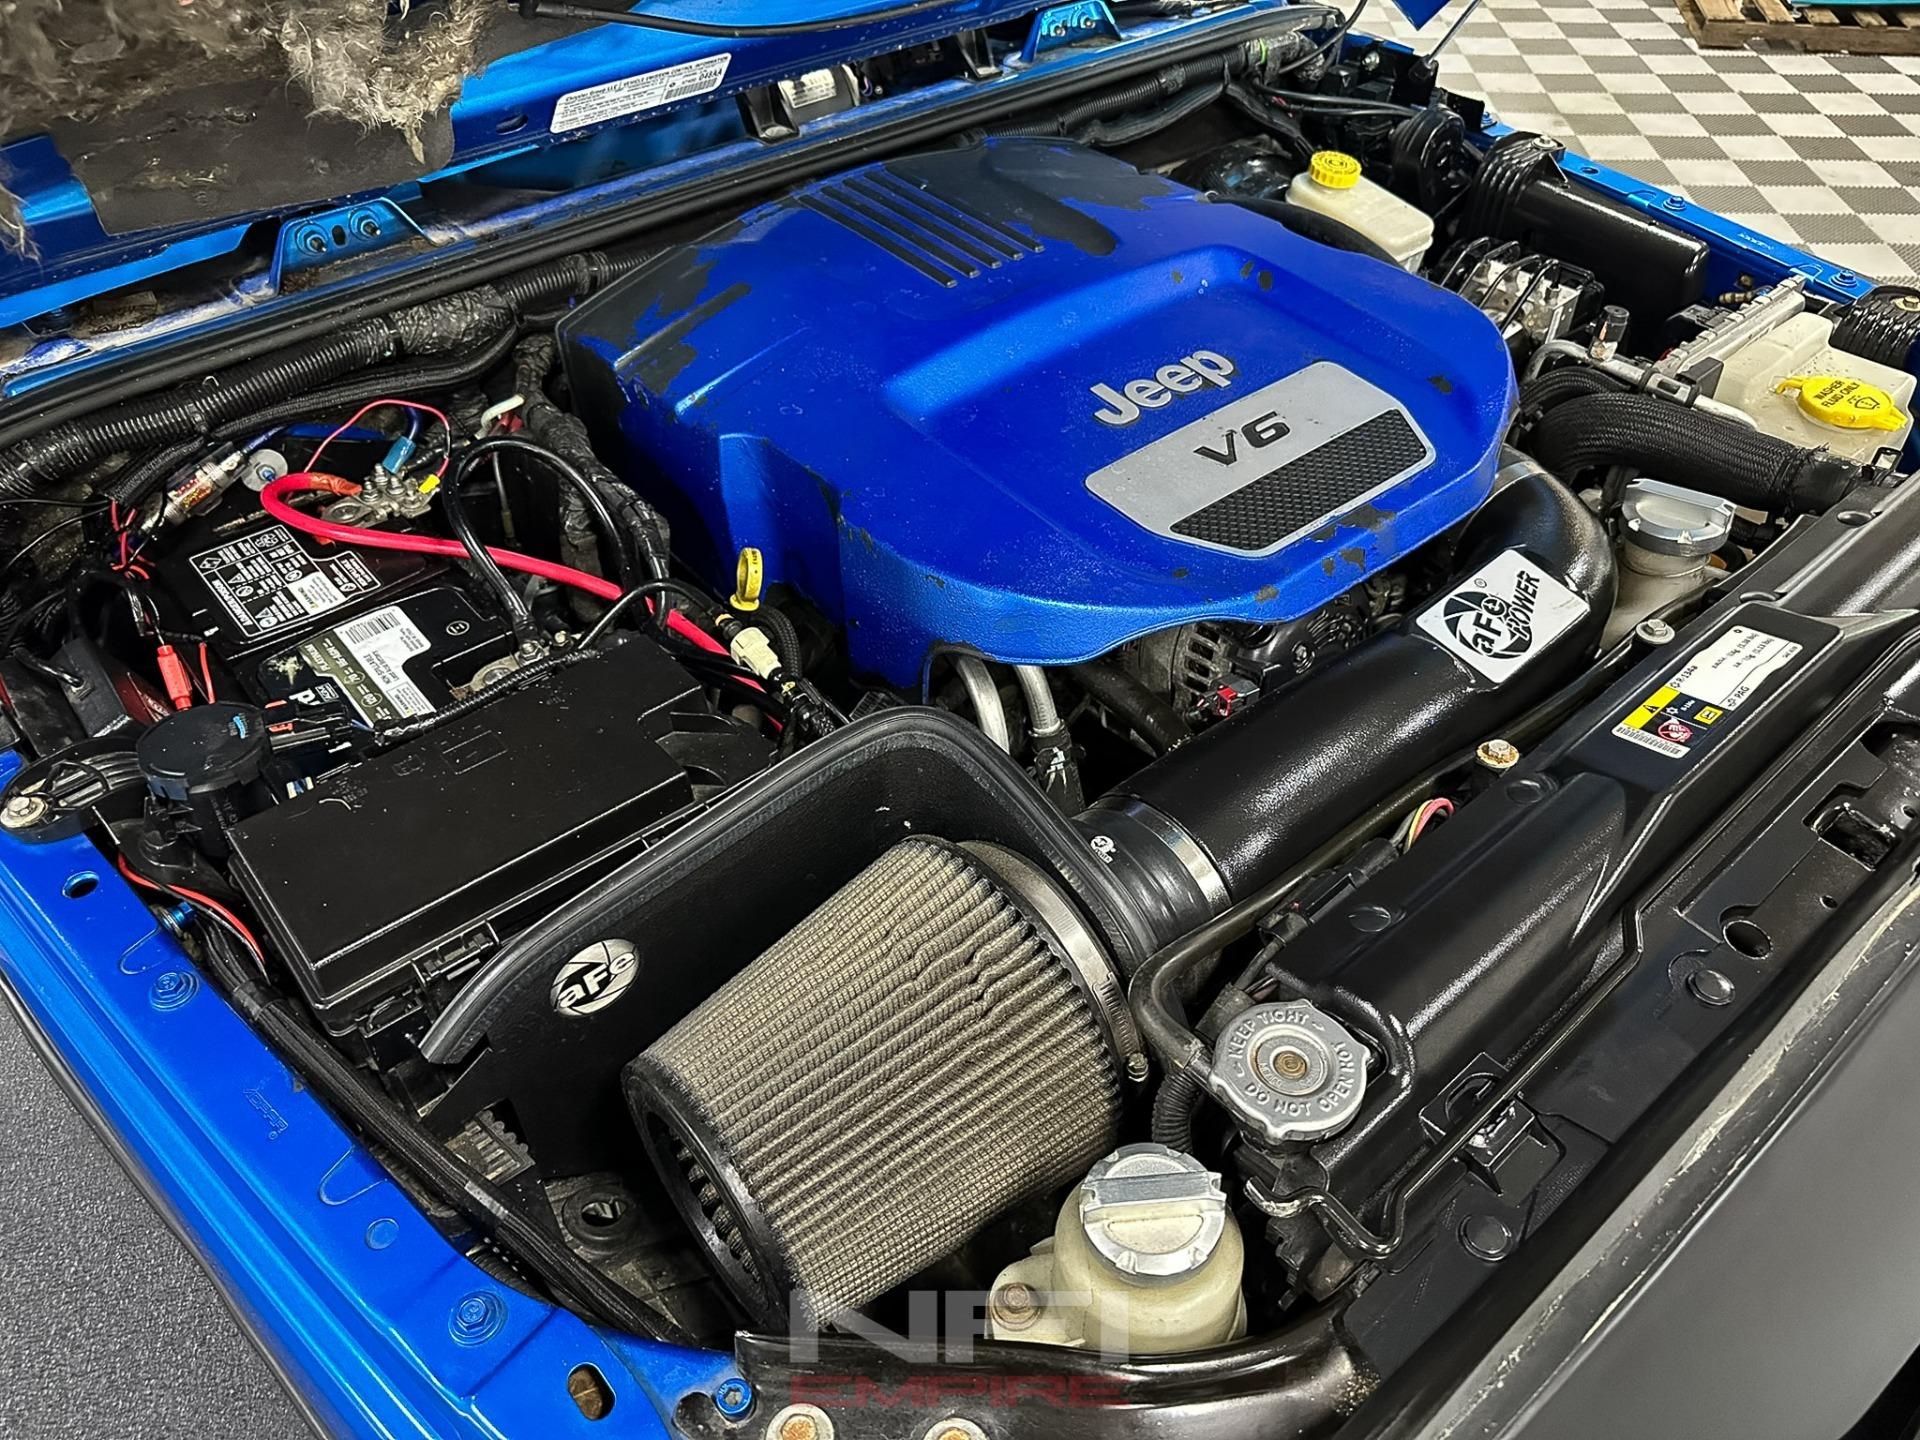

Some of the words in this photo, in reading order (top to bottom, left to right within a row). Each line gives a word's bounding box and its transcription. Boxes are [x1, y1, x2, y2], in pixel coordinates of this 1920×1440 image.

[1089, 350, 1235, 426] Jeep
[1813, 380, 1845, 399] WASHER
[1821, 394, 1844, 407] FLUID
[1840, 382, 1860, 395] ONLY
[1193, 410, 1292, 467] V6
[1506, 570, 1540, 641] POWER
[1471, 595, 1506, 655] aFe
[1734, 685, 1750, 699] PAG
[556, 951, 636, 1009] aFe
[1229, 1019, 1256, 1059] KEEP
[1257, 1008, 1310, 1025] TIGHT
[1333, 1041, 1356, 1074] HOT
[1245, 1083, 1271, 1105] DO
[1274, 1099, 1312, 1117] NOT
[1318, 1075, 1354, 1112] OPEN
